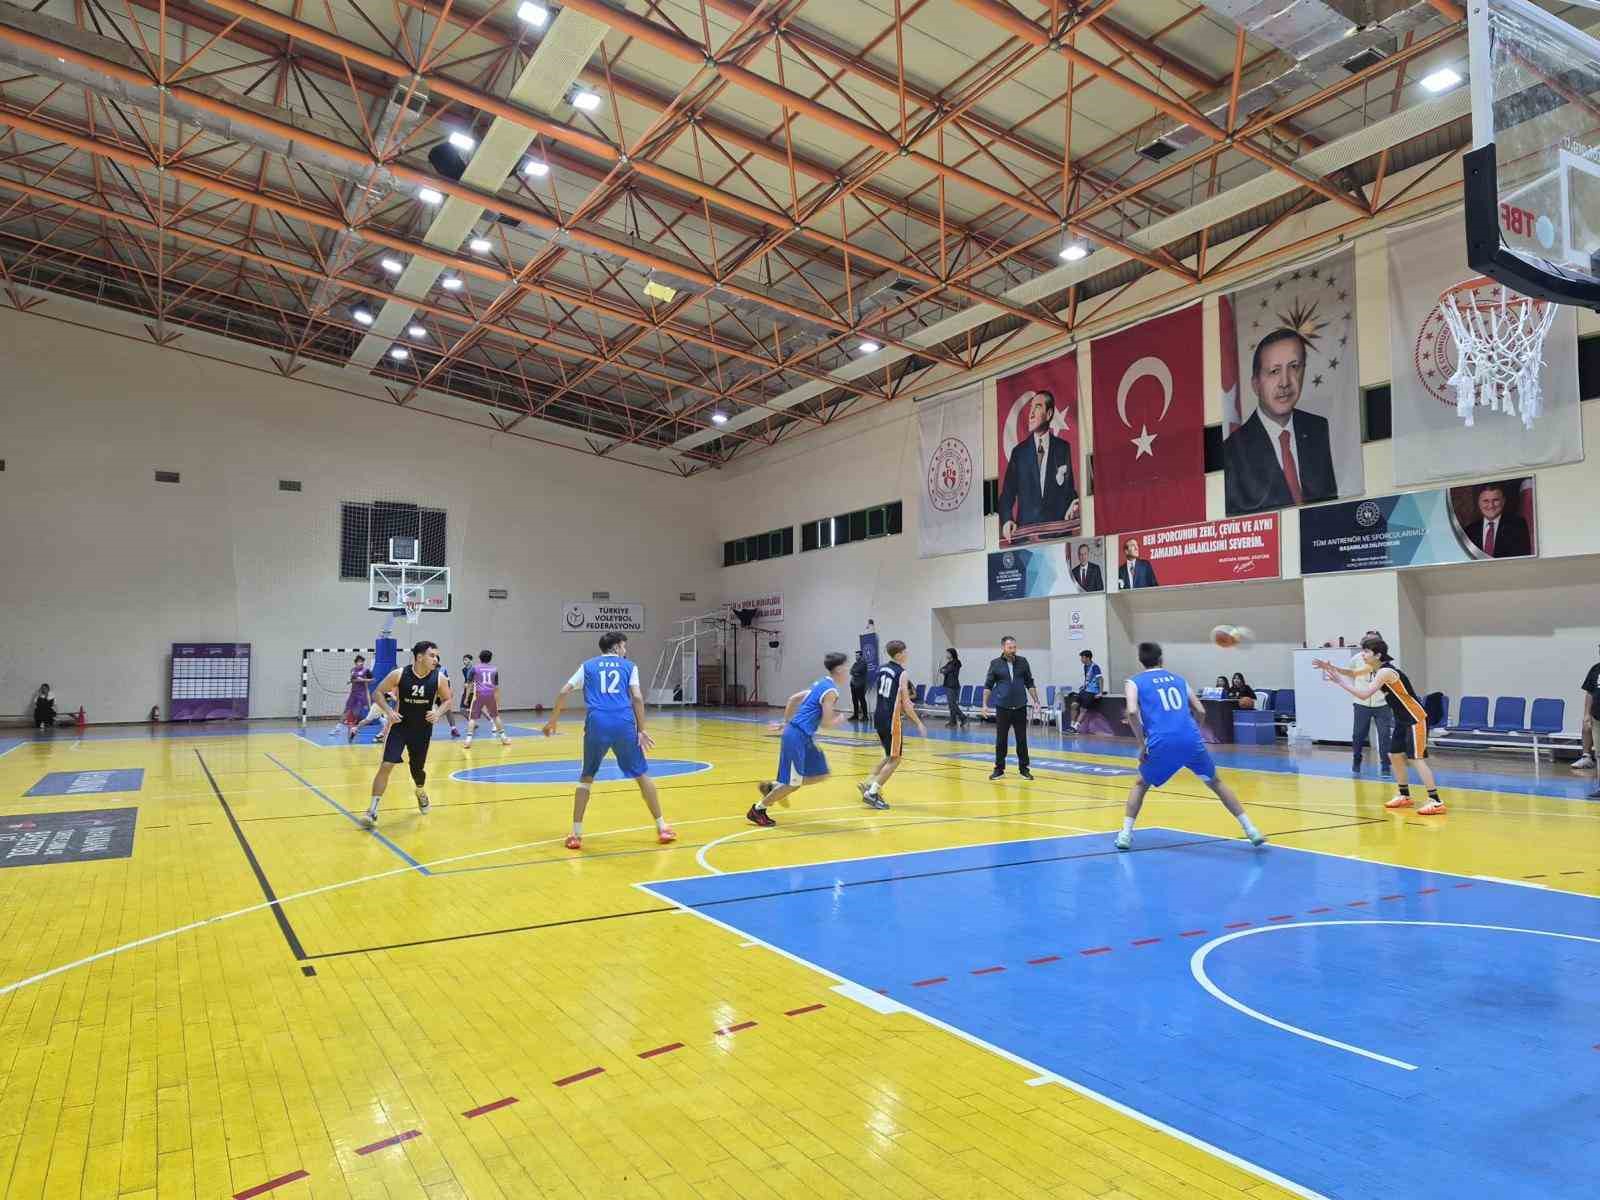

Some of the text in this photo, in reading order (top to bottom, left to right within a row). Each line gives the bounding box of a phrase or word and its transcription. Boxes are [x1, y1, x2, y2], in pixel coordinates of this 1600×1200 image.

[1143, 518, 1273, 546] BEN SPORCUNUN ZEKİ, ÇEVİK VE AYNI
[1150, 546, 1183, 559] ZAMANDA
[1229, 533, 1264, 550] SEVERİM.
[599, 606, 629, 614] TÜRKİYE
[411, 685, 425, 697] 24
[599, 669, 620, 694] 12
[1157, 686, 1183, 711] 10
